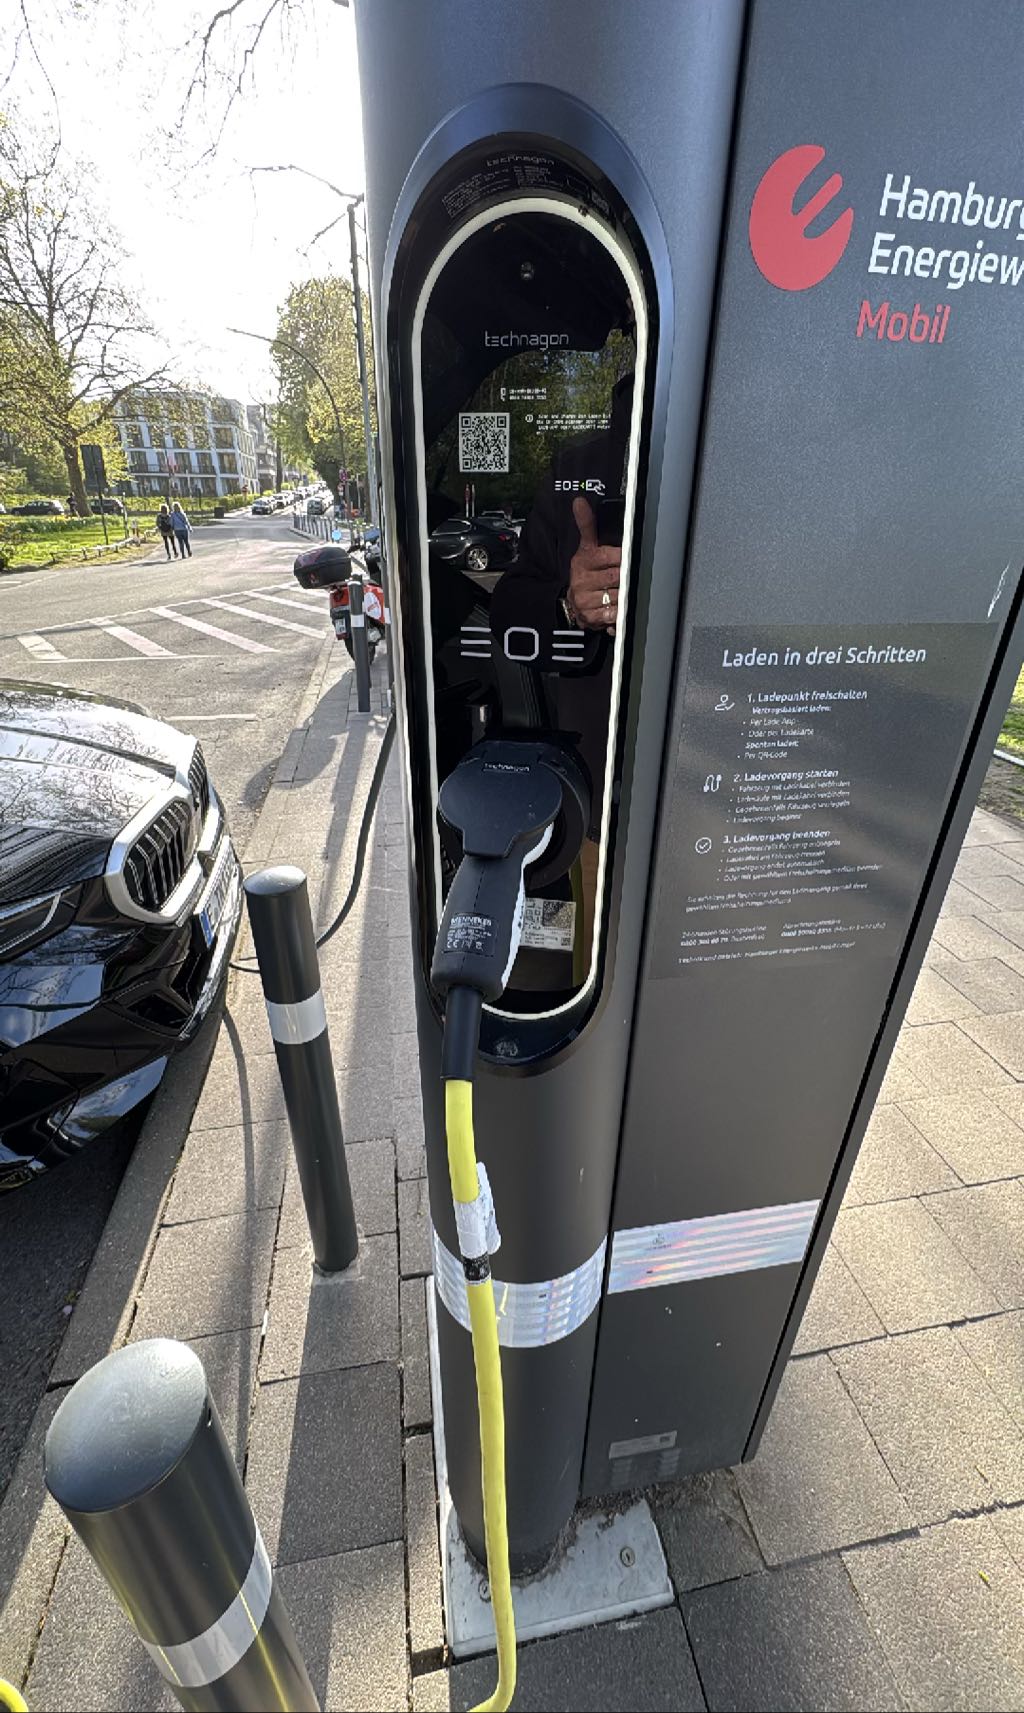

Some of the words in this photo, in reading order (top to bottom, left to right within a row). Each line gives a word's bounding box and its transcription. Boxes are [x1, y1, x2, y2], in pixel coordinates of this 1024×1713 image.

[856, 300, 951, 344] Mobil
[484, 330, 569, 350] technagon
[722, 647, 778, 667] Laden
[784, 647, 800, 665] in
[806, 646, 842, 665] drei
[845, 645, 926, 664] Schritten
[747, 693, 755, 703] 1.
[758, 691, 809, 705] Ladepunkt
[734, 774, 742, 783] 2.
[745, 771, 803, 784] Ladevorgang
[805, 769, 839, 780] starten
[733, 831, 791, 845] Ladevorgang
